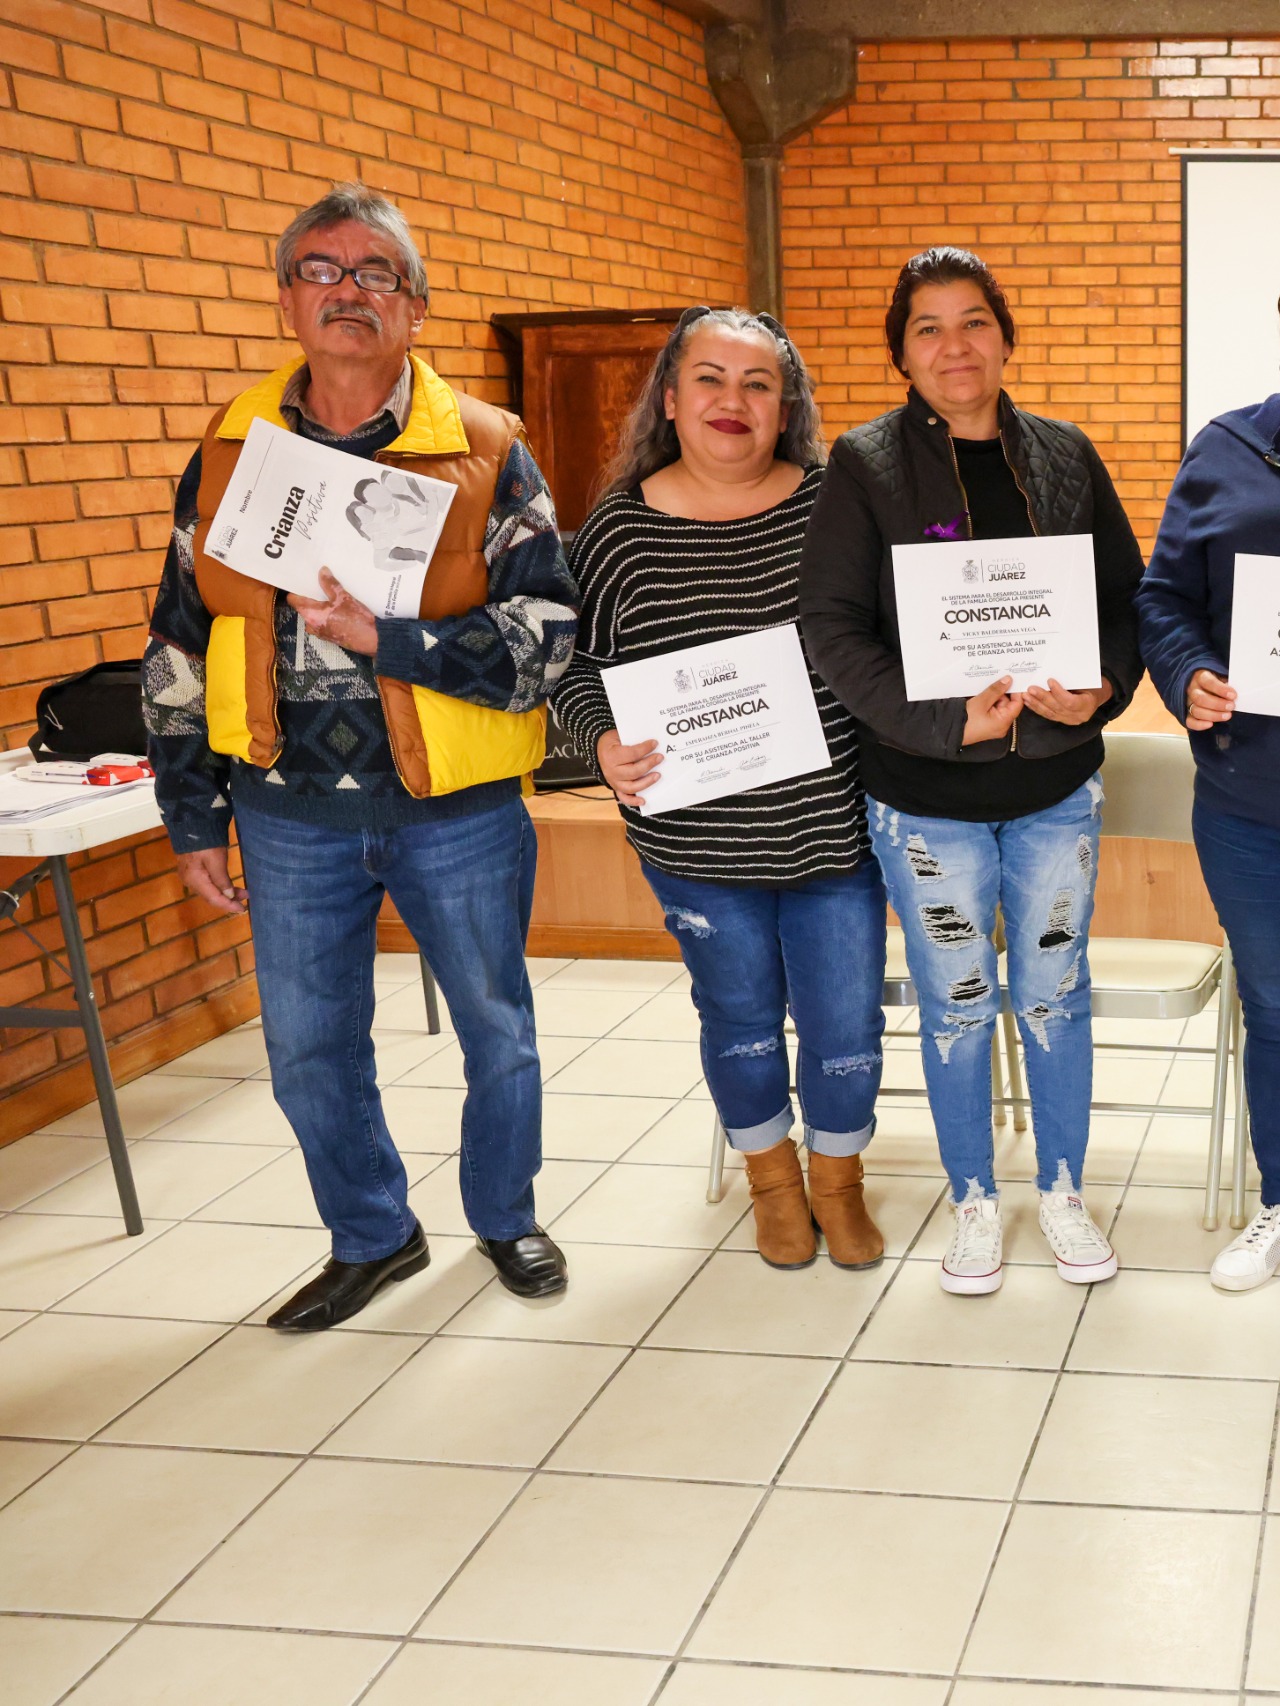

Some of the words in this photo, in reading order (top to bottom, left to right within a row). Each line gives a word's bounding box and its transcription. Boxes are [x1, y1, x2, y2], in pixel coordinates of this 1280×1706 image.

[239, 490, 252, 514] Nombre
[294, 480, 327, 540] Positiva
[264, 485, 305, 560] Crianza
[988, 562, 1025, 572] CIUDAD
[989, 570, 1025, 581] JUÁREZ
[945, 604, 1051, 624] CONSTANCIA
[940, 632, 950, 640] A:
[1270, 648, 1280, 656] A:
[699, 663, 735, 678] CIUDAD
[703, 671, 738, 686] JUÁREZ
[667, 704, 687, 713] SISTEMA
[710, 689, 743, 701] DESARROLLO
[743, 684, 766, 692] INTEGRAL
[706, 698, 727, 707] OTORGA
[736, 690, 759, 699] PRESENTE
[666, 698, 769, 735] CONSTANCIA
[666, 745, 676, 753] A:
[705, 742, 738, 754] ASISTENCIA
[749, 732, 770, 741] TALLER
[706, 750, 732, 761] CRIANZA
[734, 742, 760, 752] POSITIVA
